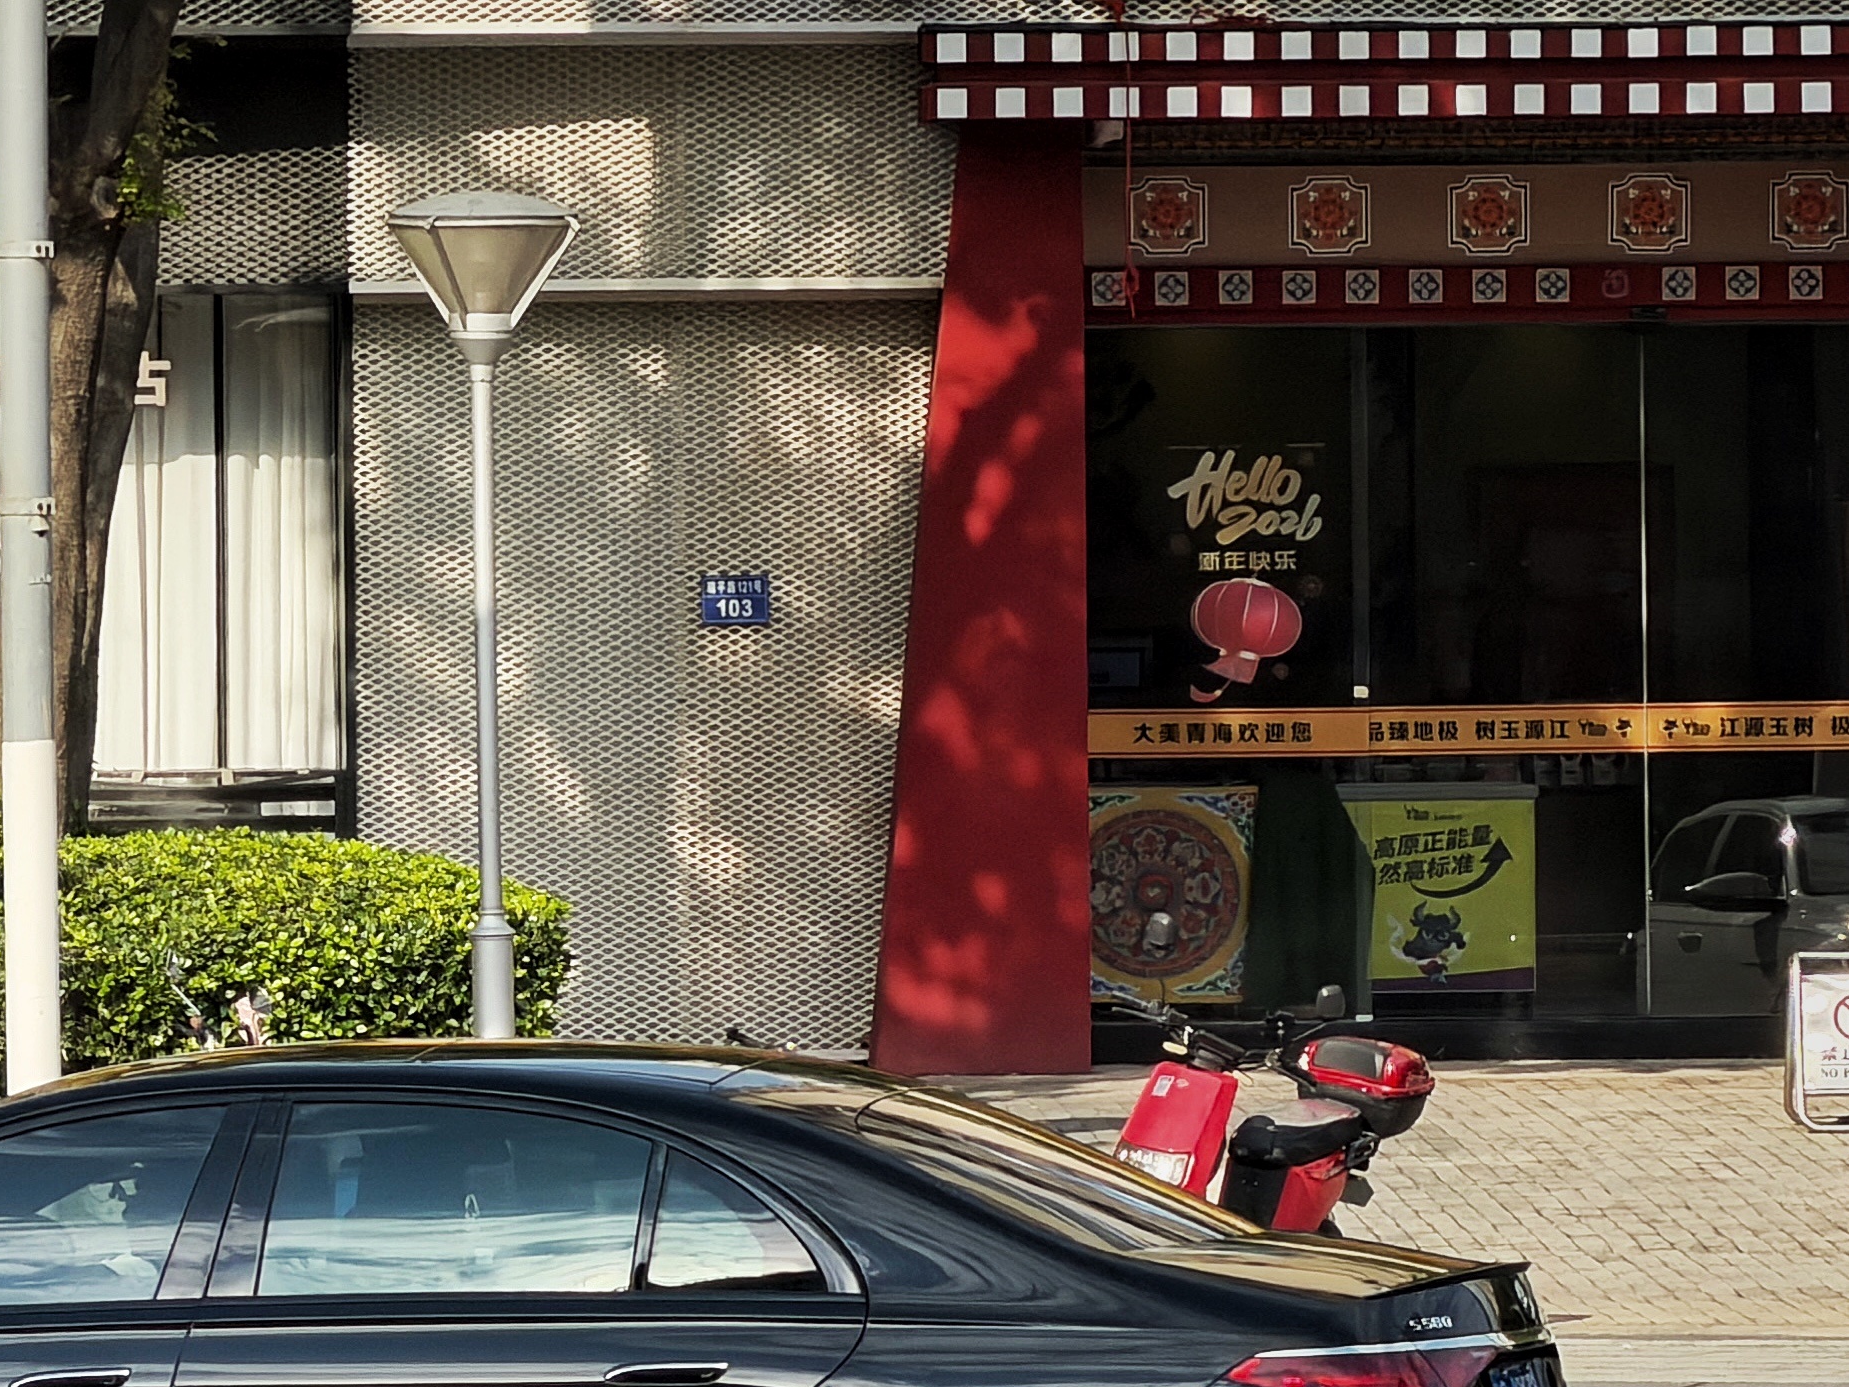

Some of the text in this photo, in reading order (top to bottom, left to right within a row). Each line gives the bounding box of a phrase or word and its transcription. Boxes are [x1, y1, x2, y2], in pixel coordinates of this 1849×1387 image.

[1167, 450, 1302, 530] Hello
[1216, 494, 1322, 546] 2026
[1198, 551, 1297, 571] 新年快乐
[716, 599, 753, 617] 103
[1133, 722, 1313, 744] 大美青海欢迎您
[1719, 716, 1814, 738] 江源玉树
[1373, 824, 1494, 861] 高原正能量
